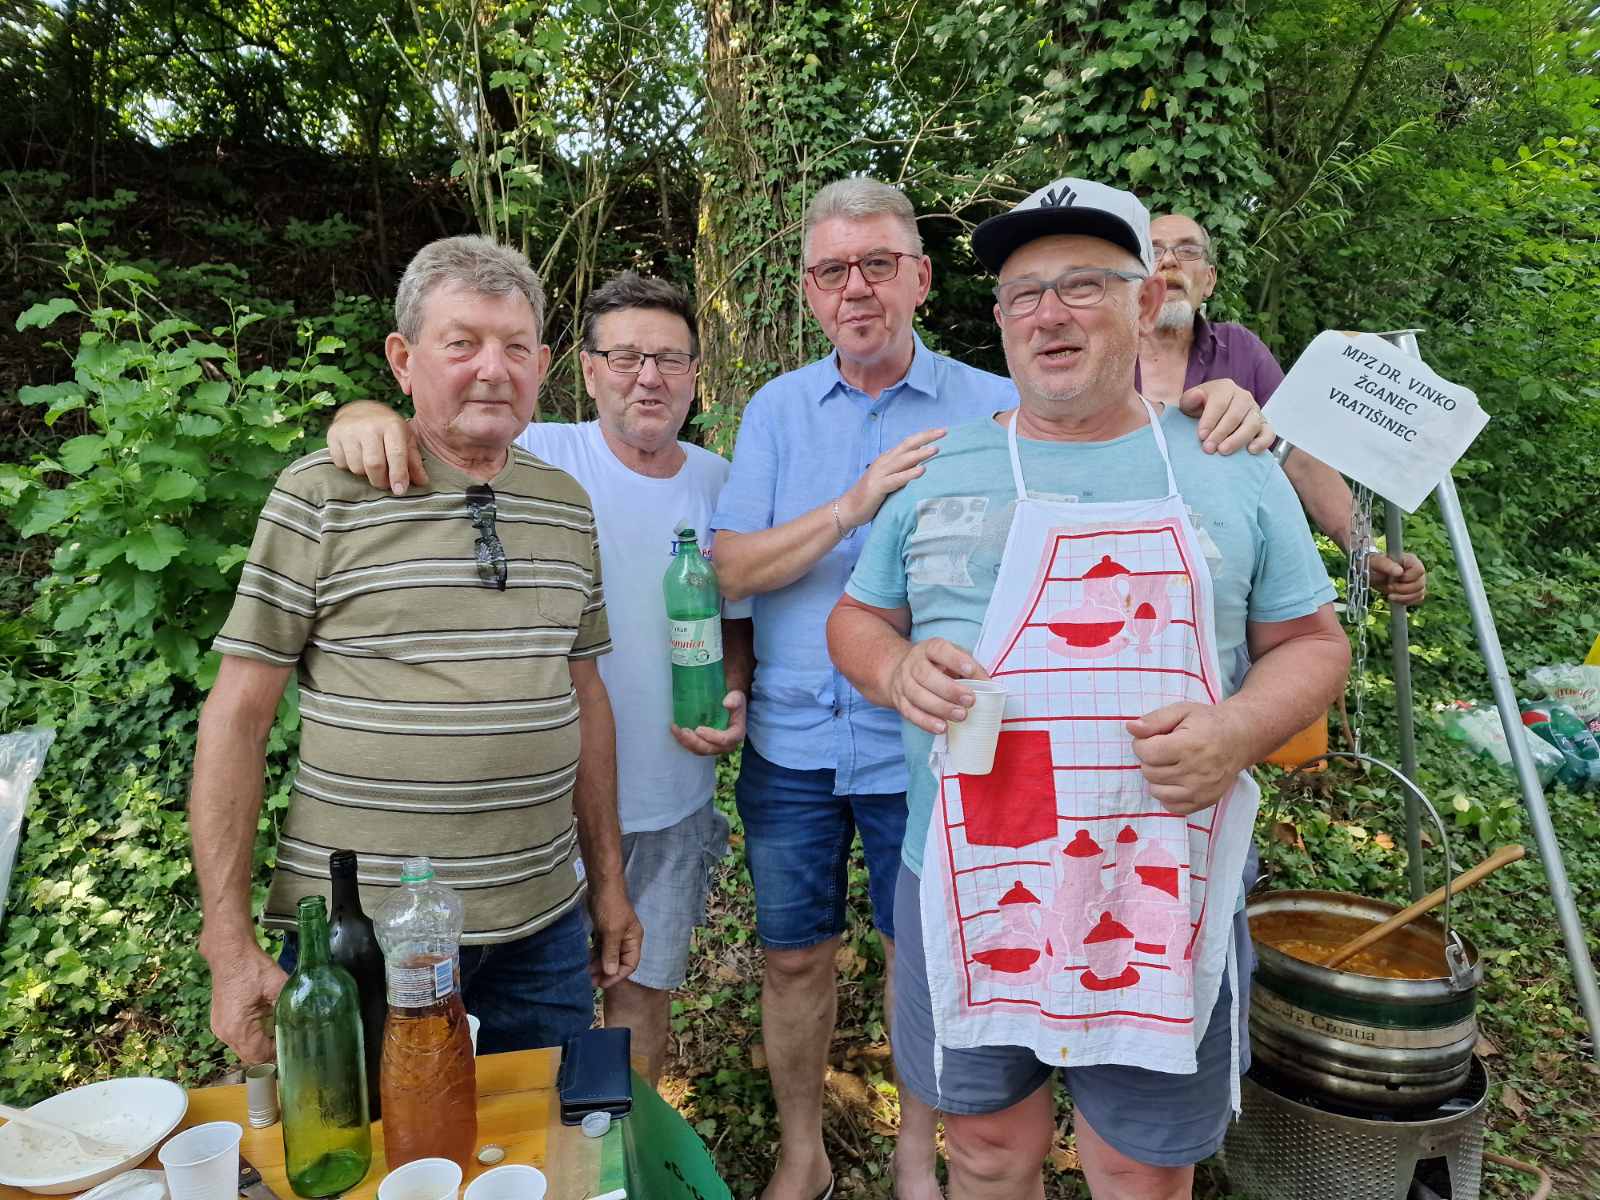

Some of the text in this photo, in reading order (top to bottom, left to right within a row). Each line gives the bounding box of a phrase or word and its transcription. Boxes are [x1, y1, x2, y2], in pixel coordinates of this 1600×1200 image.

[1342, 345, 1457, 412] MPZ DR. VINKO
[1354, 375, 1418, 416] ŽGANEC
[1329, 387, 1417, 442] VRATIŠINEC
[1312, 1015, 1375, 1042] Croatia
